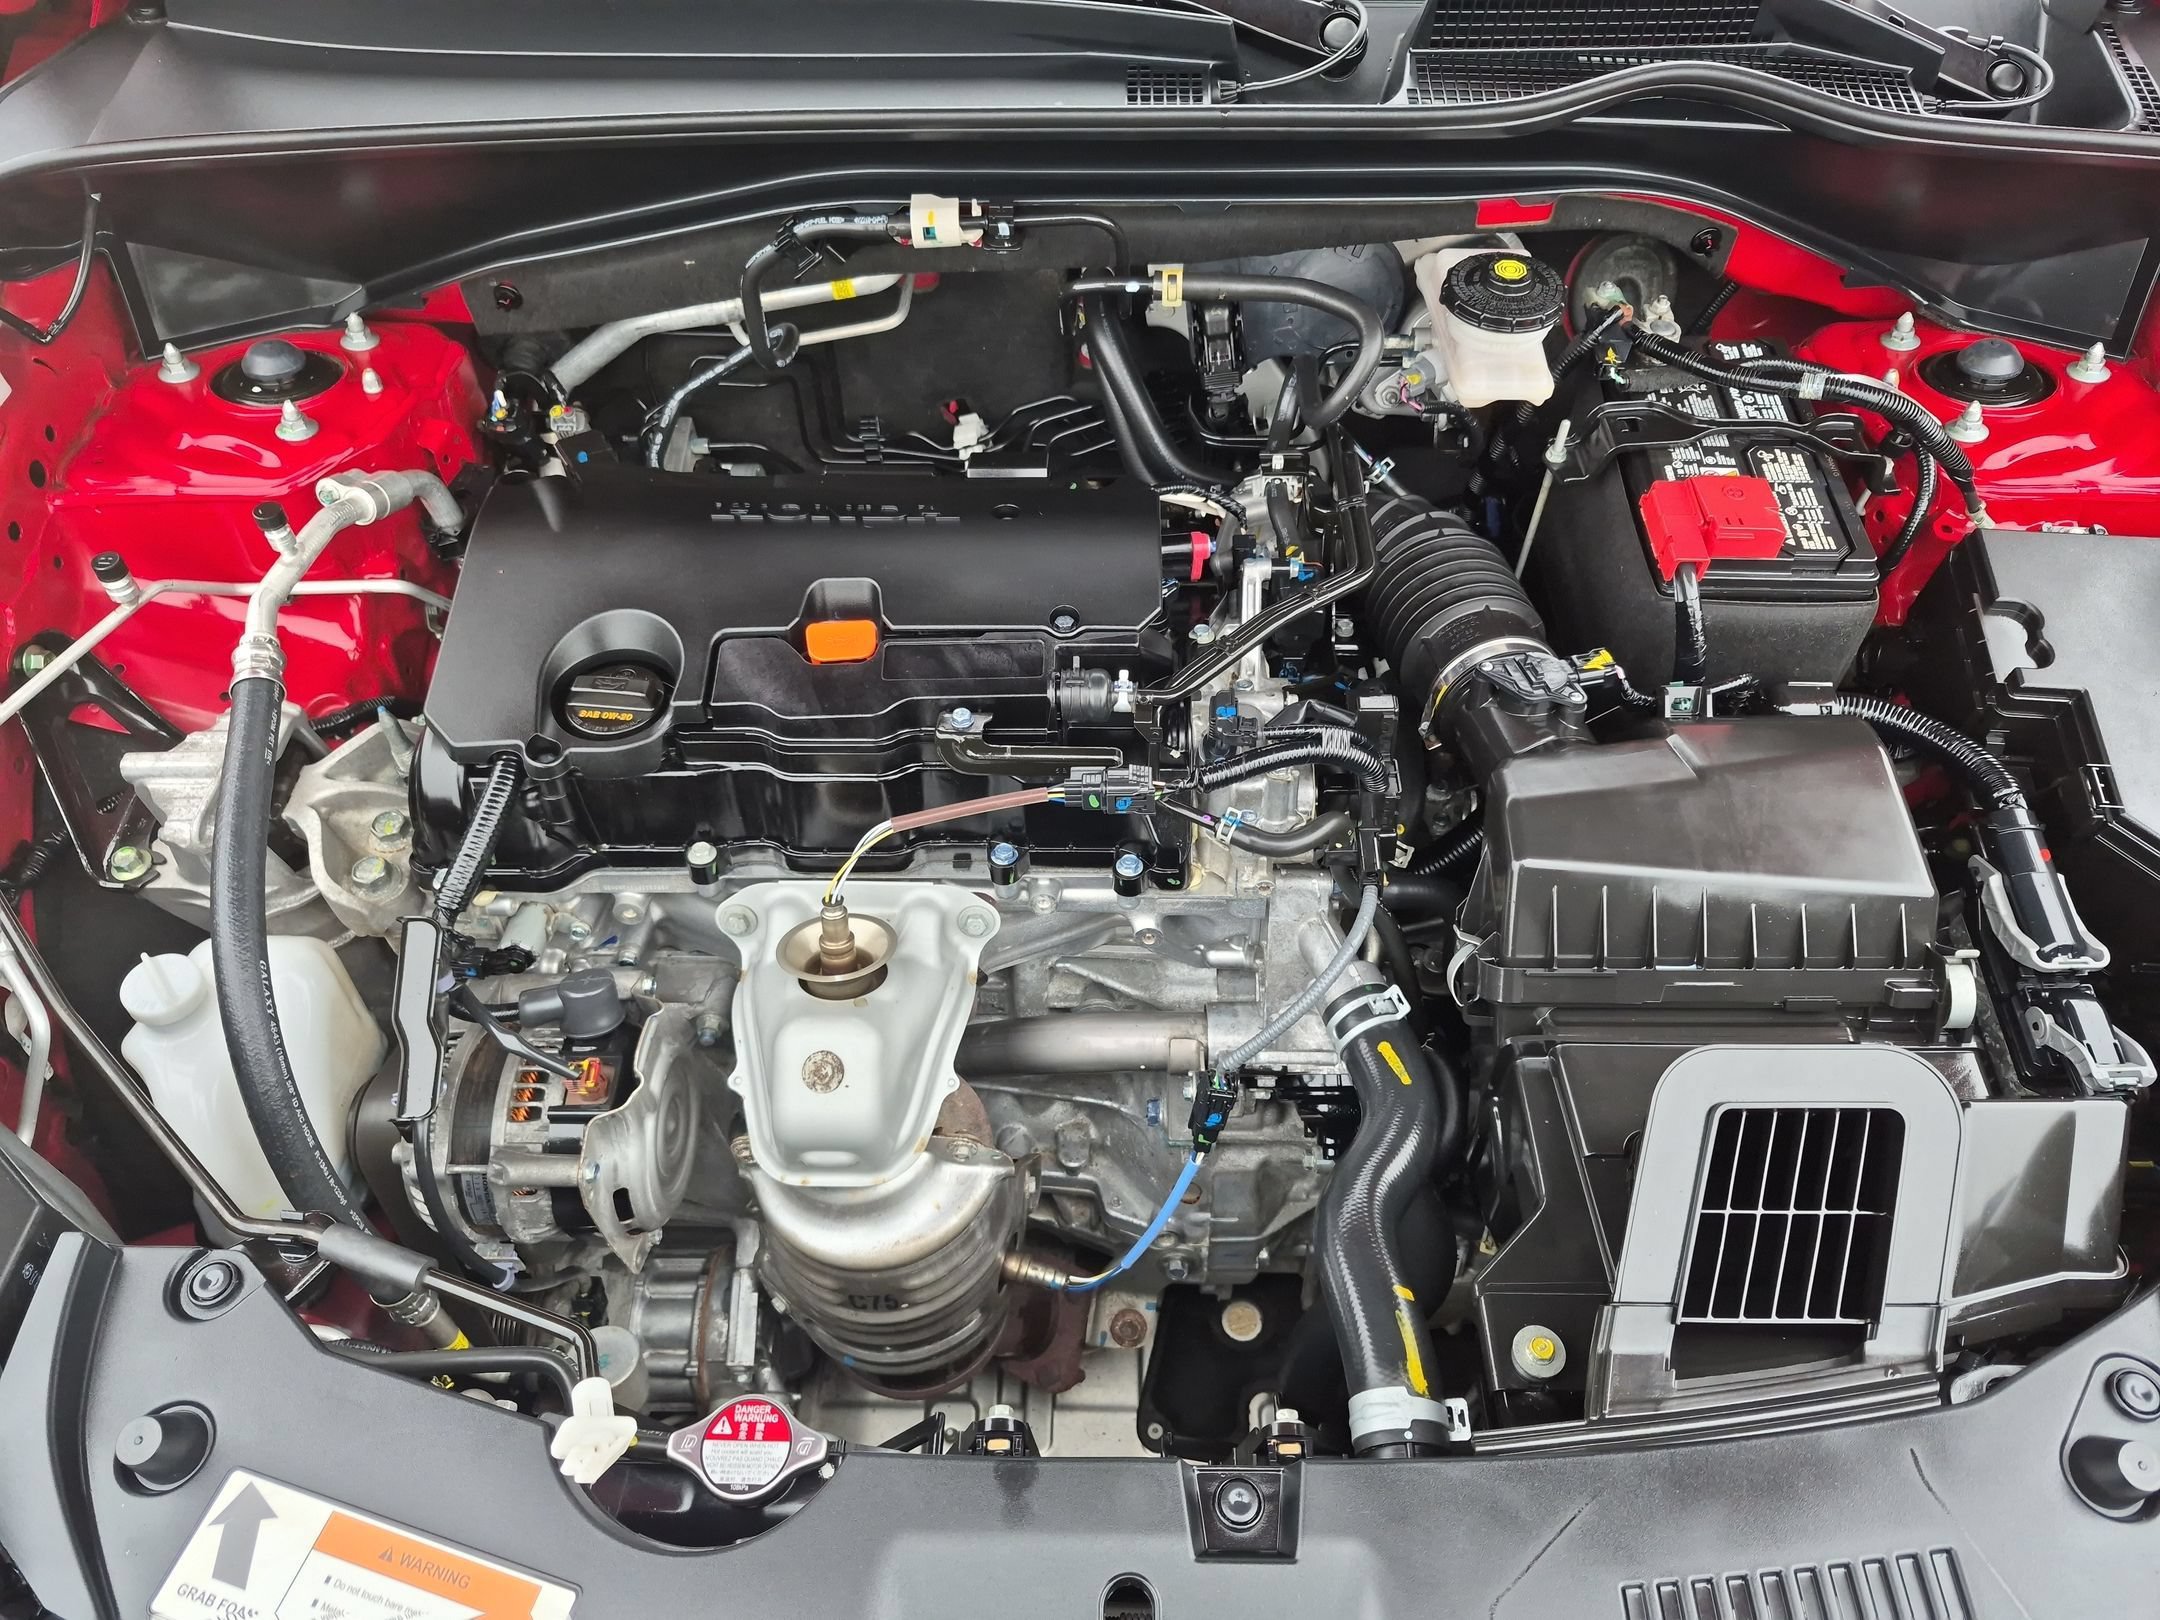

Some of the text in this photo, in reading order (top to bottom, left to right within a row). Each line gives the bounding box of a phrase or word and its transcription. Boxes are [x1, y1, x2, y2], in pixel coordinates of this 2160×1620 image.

[579, 710, 633, 721] SAE 0W-20
[259, 960, 276, 1018] GALAXY
[270, 1020, 281, 1045] 4843
[276, 1047, 288, 1080] (16mm)
[296, 1107, 305, 1124] A/C
[302, 1123, 315, 1148] HOSE
[735, 1404, 772, 1413] DANGER
[734, 1414, 778, 1423] WARNUNG
[399, 1551, 471, 1590] WARNING
[177, 1583, 217, 1607] GRAB
